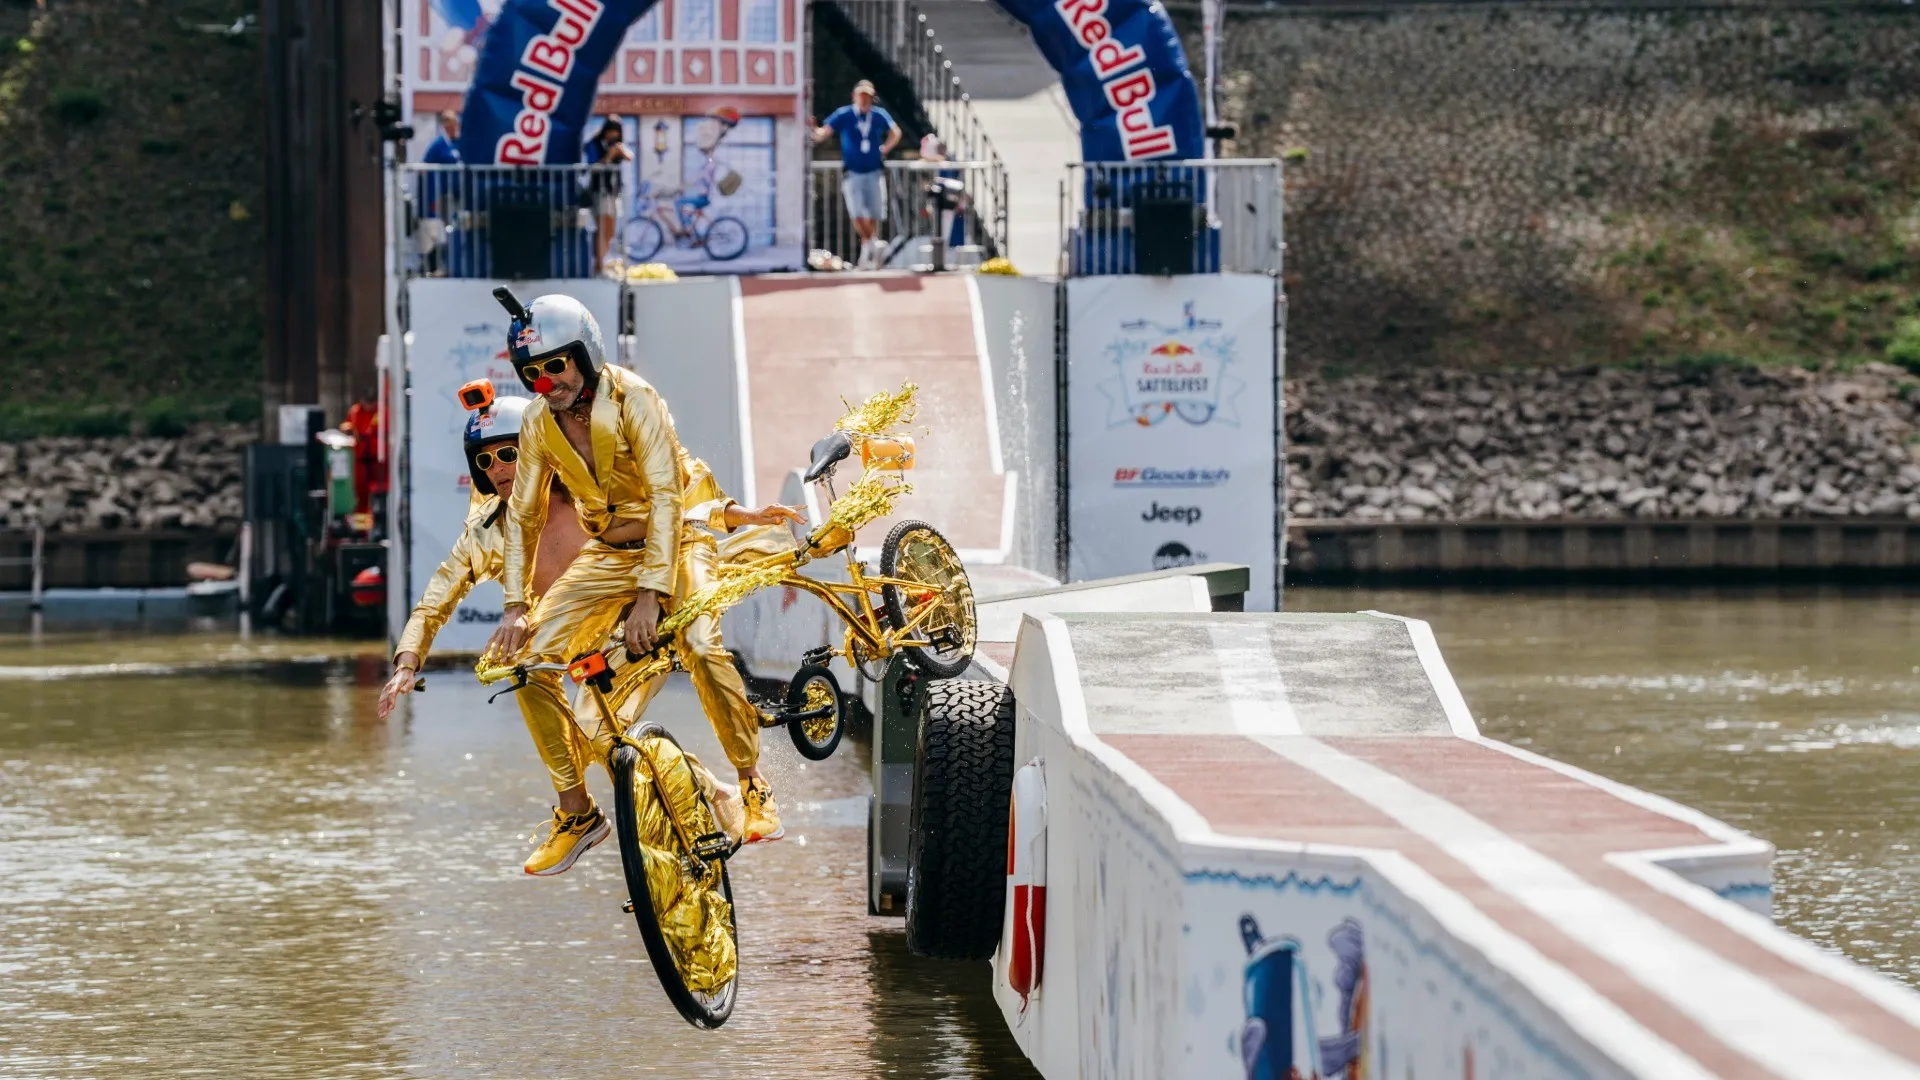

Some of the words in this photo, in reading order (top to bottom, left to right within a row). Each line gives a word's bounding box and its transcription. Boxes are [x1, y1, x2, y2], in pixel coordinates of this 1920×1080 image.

[526, 0, 601, 78] Bull
[1060, 0, 1141, 73] Red
[1110, 73, 1172, 158] Bull
[498, 75, 560, 167] Red
[1137, 377, 1208, 393] SATTELFEST
[1142, 501, 1202, 526] Jeep
[457, 607, 504, 624] Shar
